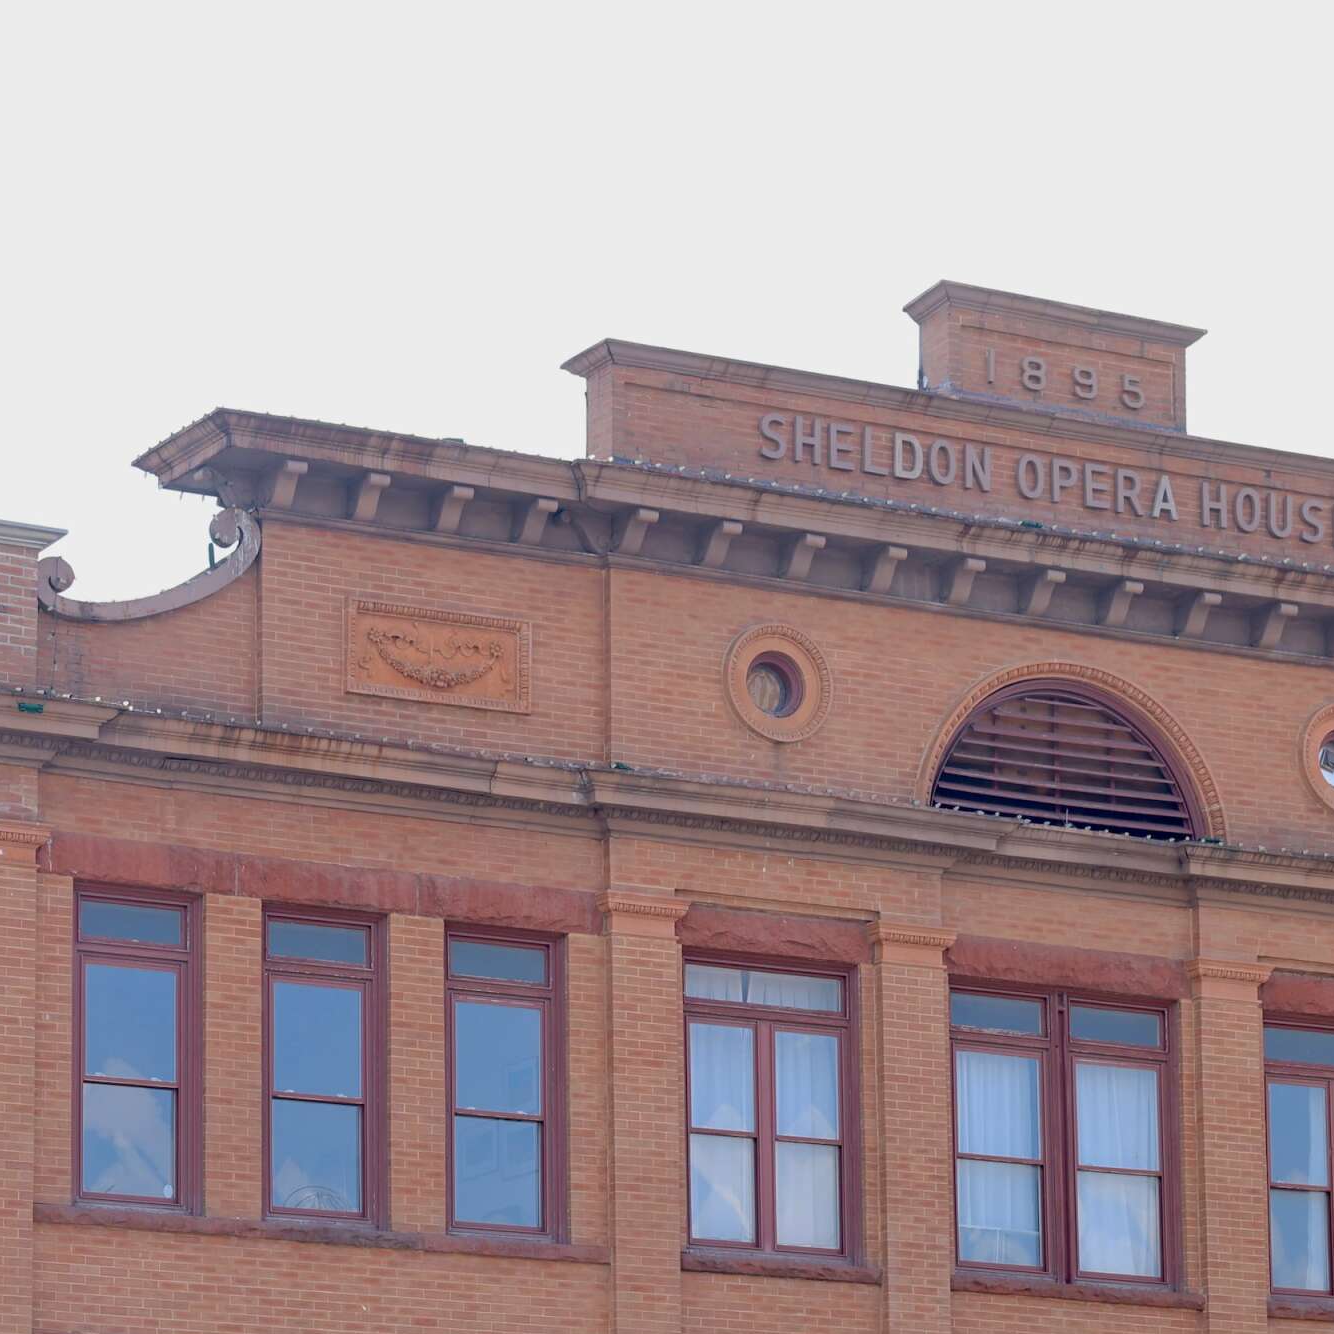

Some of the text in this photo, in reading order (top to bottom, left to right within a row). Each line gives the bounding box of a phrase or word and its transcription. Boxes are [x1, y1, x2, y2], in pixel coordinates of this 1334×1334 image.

[982, 348, 1146, 409] 1895
[758, 413, 992, 492] SHELDON
[1017, 455, 1179, 522] OPERA
